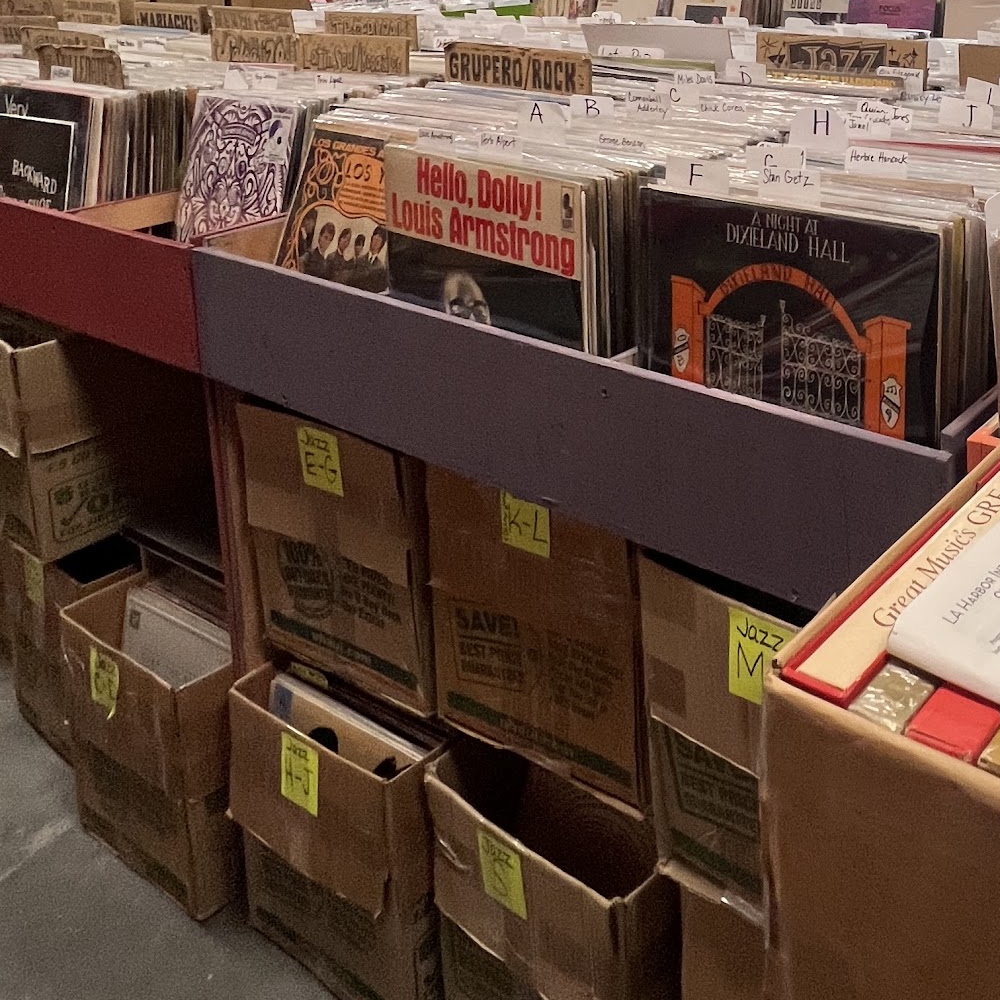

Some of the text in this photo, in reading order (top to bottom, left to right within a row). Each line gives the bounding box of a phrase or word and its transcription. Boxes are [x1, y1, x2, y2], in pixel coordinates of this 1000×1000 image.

[879, 4, 901, 13] FOCUS
[138, 11, 194, 33] MARIACHI
[450, 52, 577, 94] GRUPERO/ROCK
[677, 74, 713, 85] Miles Davis
[5, 93, 29, 117] Very
[669, 88, 681, 103] C
[530, 102, 543, 124] A
[585, 98, 600, 119] B
[962, 105, 978, 127] J
[814, 109, 829, 135] H
[850, 151, 908, 164] Herbie Hancock
[346, 161, 372, 182] LOS
[689, 163, 703, 187] F
[763, 169, 814, 187] Stan Getz
[416, 156, 473, 208] Hello,
[477, 169, 542, 222] Dolly!
[392, 192, 443, 240] Louis
[449, 206, 575, 277] Armstrong
[751, 211, 819, 236] A NIGHT AT
[726, 223, 850, 264] DIXIELAND HALL
[719, 266, 792, 296] DIXIELAND
[873, 579, 927, 628] Great
[916, 528, 977, 582] Music's
[942, 609, 964, 625] LA
[957, 576, 997, 611] HARBOR
[457, 606, 520, 638] SAVE!
[736, 616, 785, 652] Jazz
[736, 644, 765, 677] M
